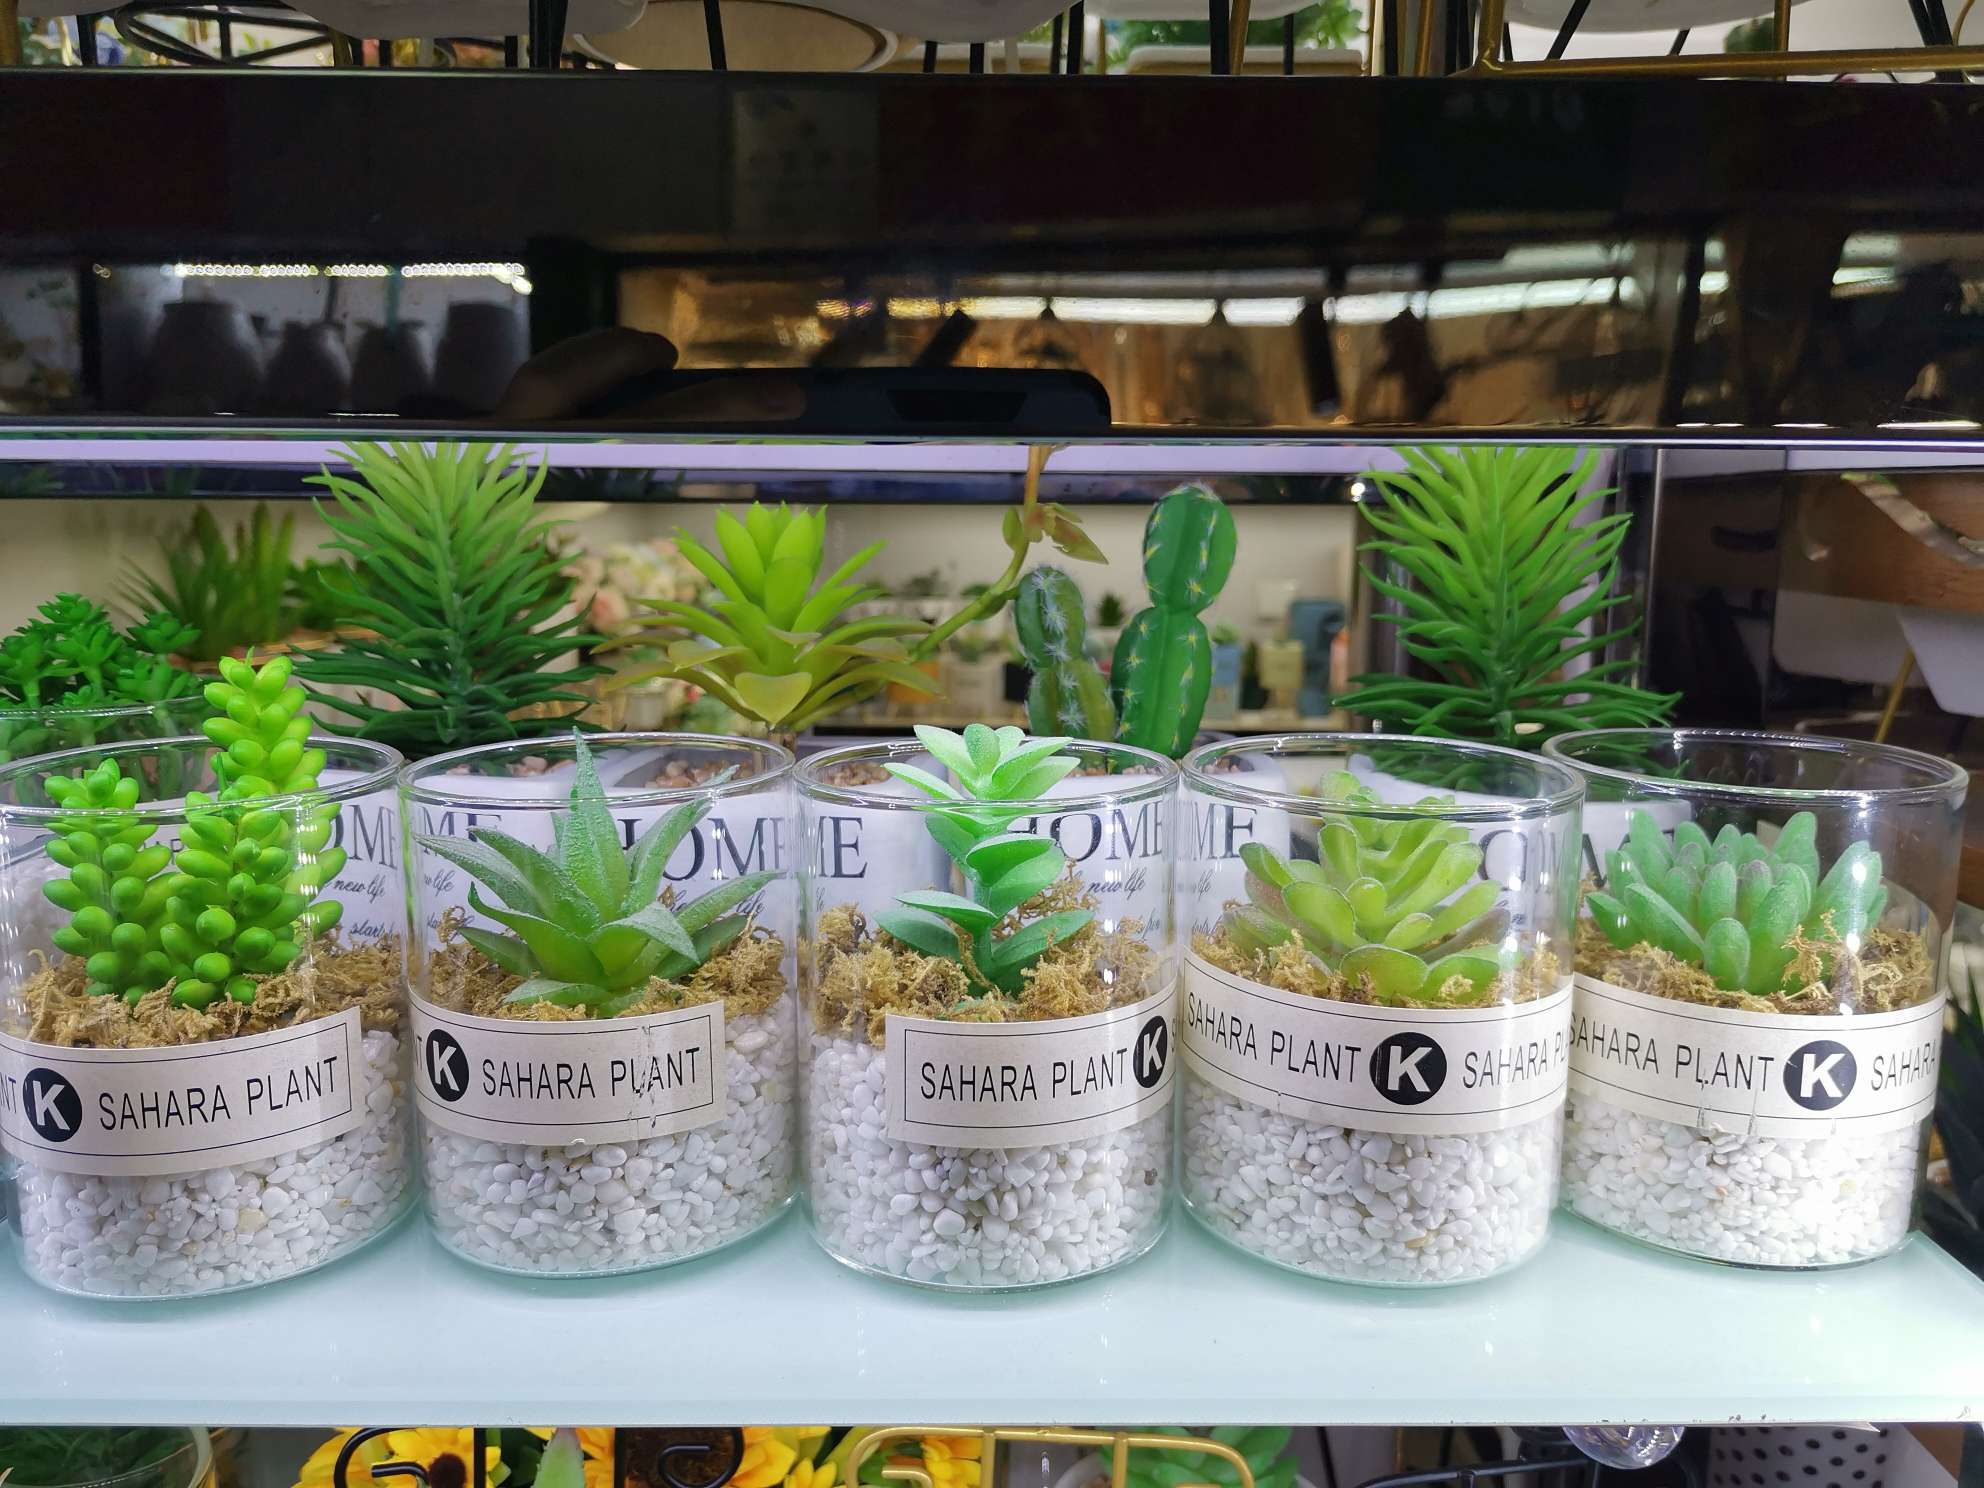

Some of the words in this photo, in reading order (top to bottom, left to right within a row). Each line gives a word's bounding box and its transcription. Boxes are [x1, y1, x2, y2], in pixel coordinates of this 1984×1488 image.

[482, 1058, 596, 1100] SAHARA
[611, 1047, 700, 1097] PLANT
[920, 1061, 1038, 1103] SAHARA
[1052, 1048, 1128, 1099] PLANT
[1187, 991, 1258, 1060] SAHARA
[1270, 1030, 1362, 1084] PLANT
[1463, 1038, 1548, 1089] SAHARA
[1569, 1011, 1659, 1074] SAHARA
[1675, 1044, 1775, 1092] PLANT
[1871, 1039, 1936, 1091] SAHARA
[99, 1084, 231, 1131] SAHARA
[247, 1056, 339, 1115] PLANT
